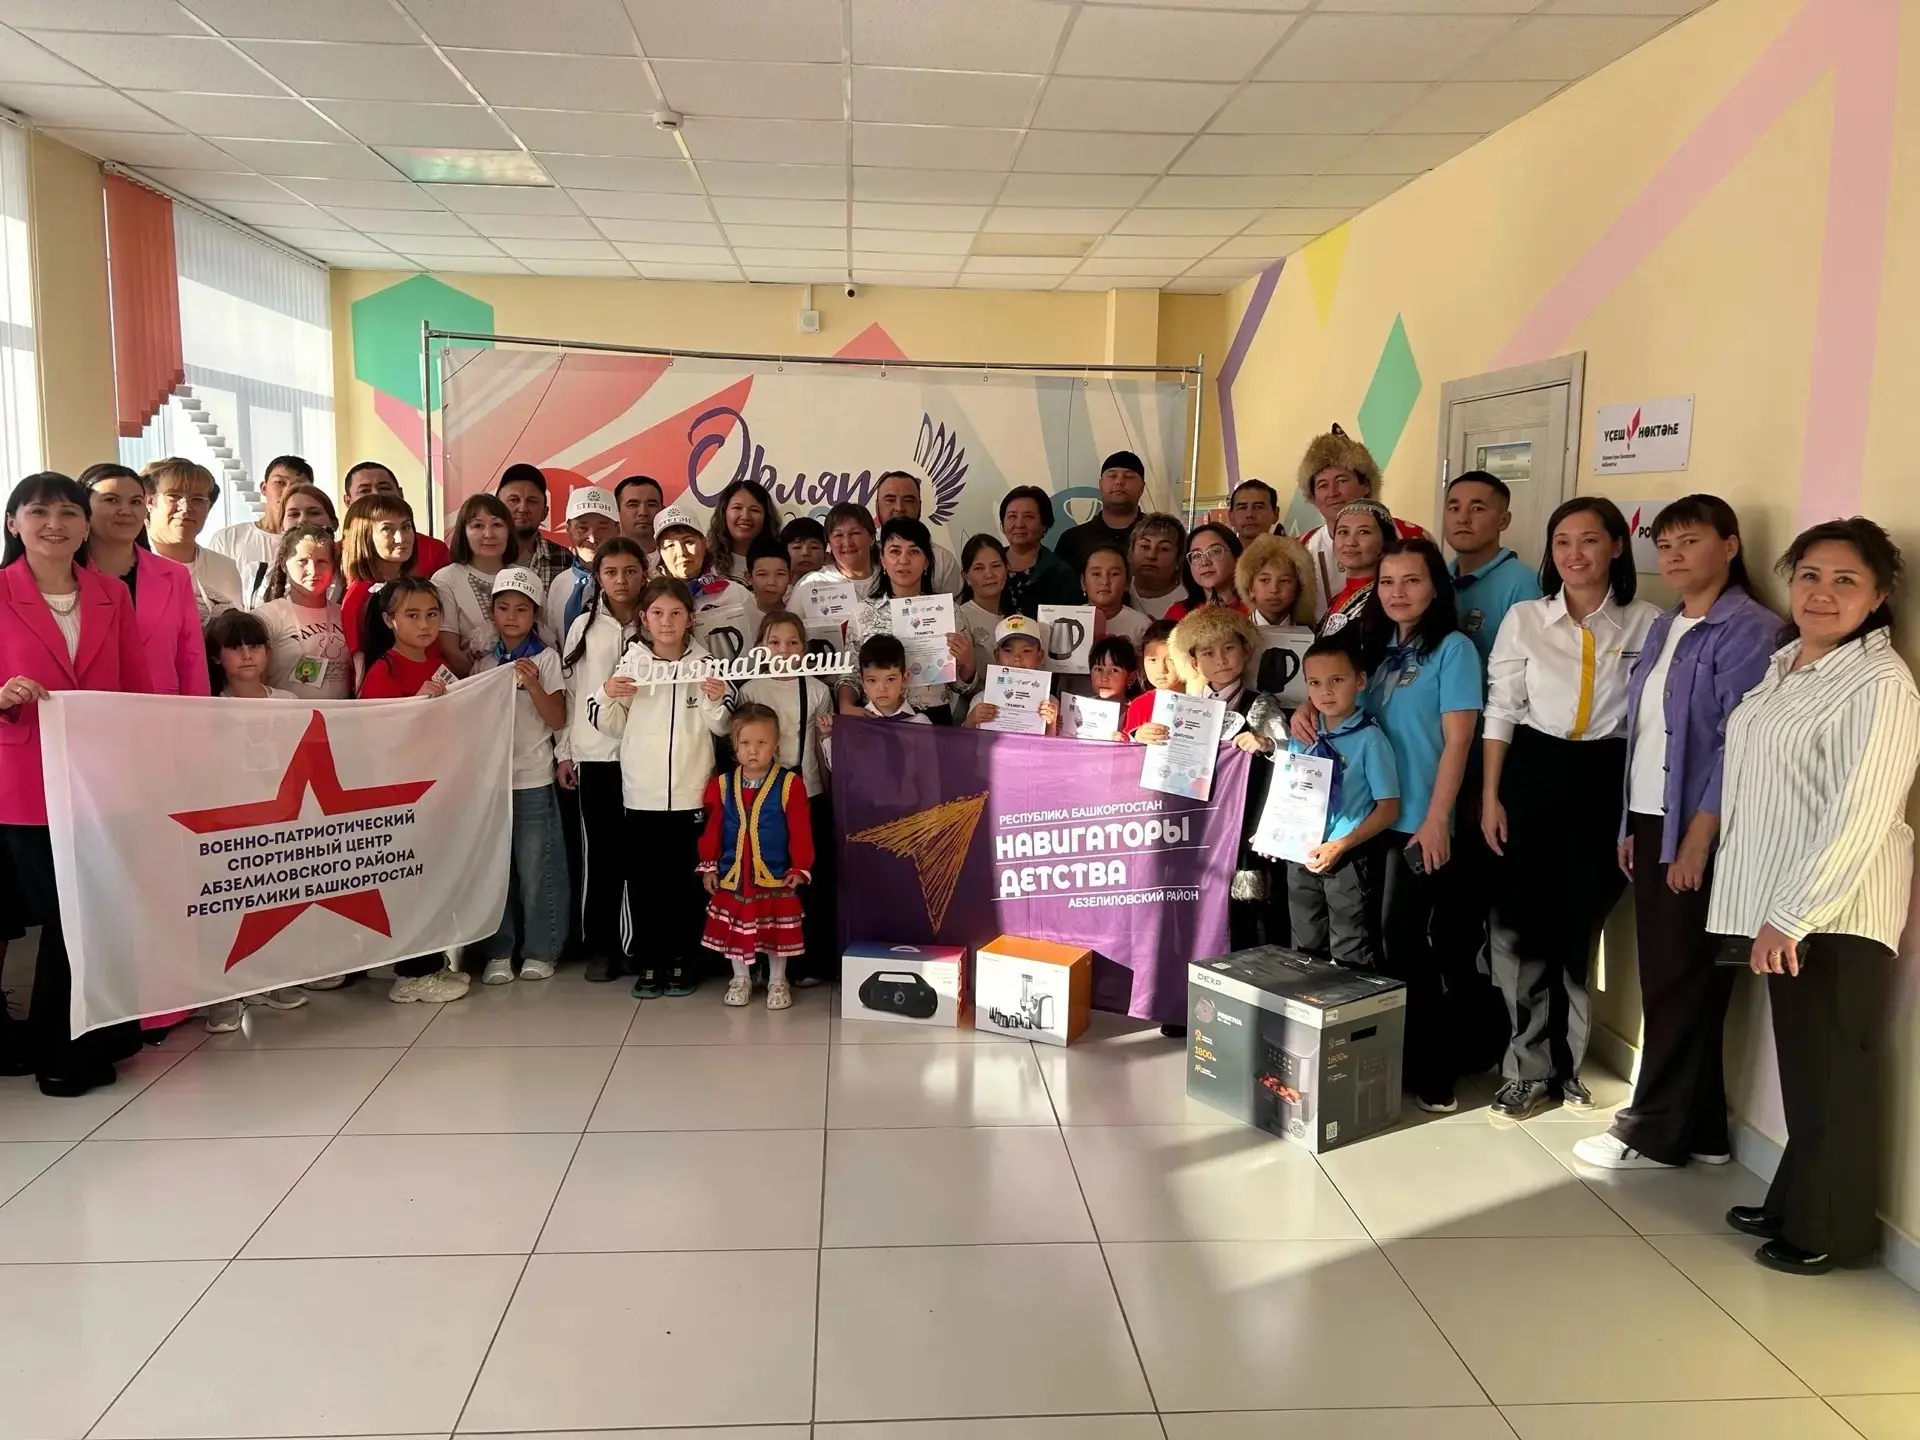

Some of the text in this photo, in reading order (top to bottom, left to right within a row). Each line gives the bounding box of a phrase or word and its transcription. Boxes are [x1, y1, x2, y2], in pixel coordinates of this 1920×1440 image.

[688, 406, 921, 508] Орлят
[199, 809, 415, 856] ВОЕННО-ПАТРИОТИЧЕСКИЙ
[1000, 800, 1162, 825] РЕСПУБЛИКА БАШКОРТОСТАН
[227, 833, 392, 871] СПОРТИВНЫЙ ЦЕНТР
[996, 816, 1189, 860] НАВИГАТОРЫ
[187, 863, 423, 917] РЕСПУБЛИКИ БАШКОРТОСТАН
[200, 848, 415, 896] АБЗЕЛИЛОВСКОГО РАЙОНА
[1000, 859, 1126, 898] ДЕТСТВА
[1068, 889, 1198, 908] АБЗЕЛИЛОВСКИЙ РАЙОН
[1197, 972, 1222, 986] DEXP
